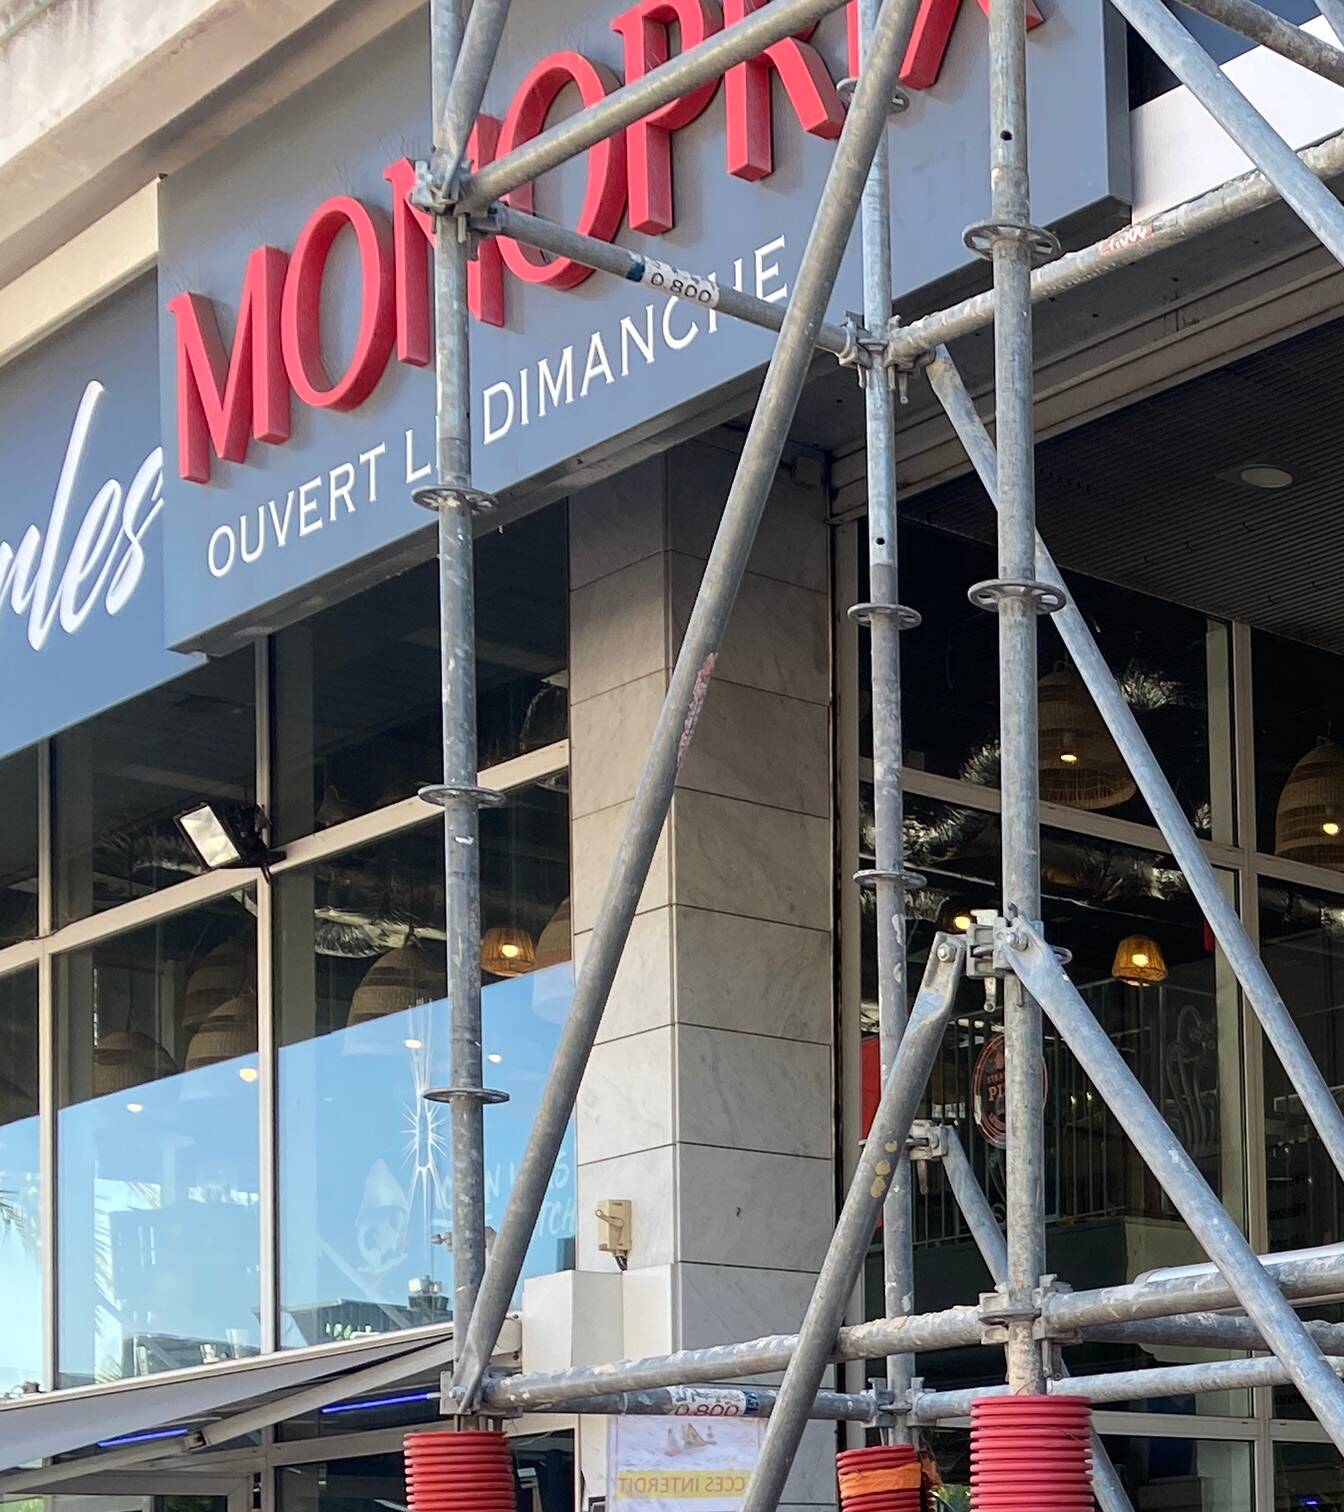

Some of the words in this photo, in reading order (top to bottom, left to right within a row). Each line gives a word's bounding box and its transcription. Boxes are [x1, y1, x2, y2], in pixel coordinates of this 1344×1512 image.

[167, 0, 1045, 483] MONOPR
[207, 441, 386, 577] OUVERT
[405, 417, 438, 484] L
[482, 234, 788, 445] DIMANCHE
